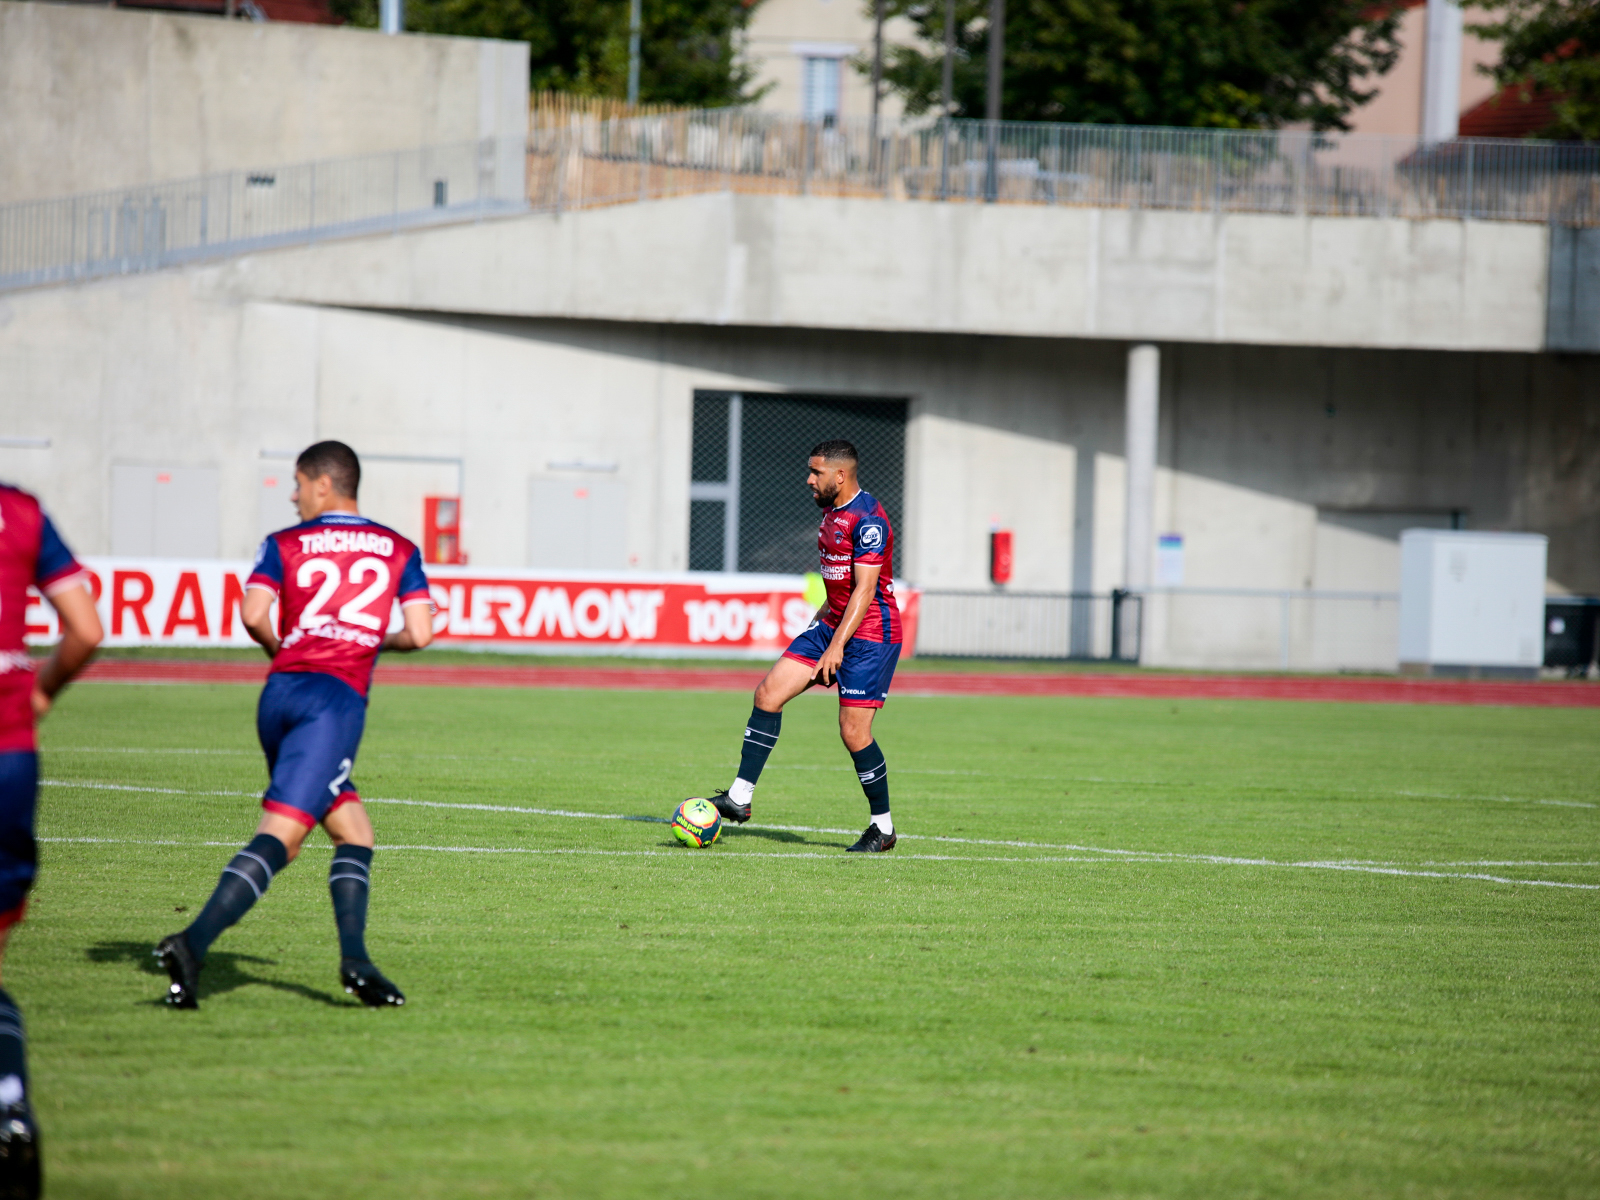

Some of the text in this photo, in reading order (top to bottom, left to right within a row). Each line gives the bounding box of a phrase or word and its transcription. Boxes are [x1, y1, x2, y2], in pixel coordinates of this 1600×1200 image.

[298, 528, 395, 557] TRICHARD
[296, 556, 391, 632] 22
[431, 583, 665, 640] CLERMONT
[683, 598, 781, 643] 100%
[846, 688, 866, 696] VEOLIA
